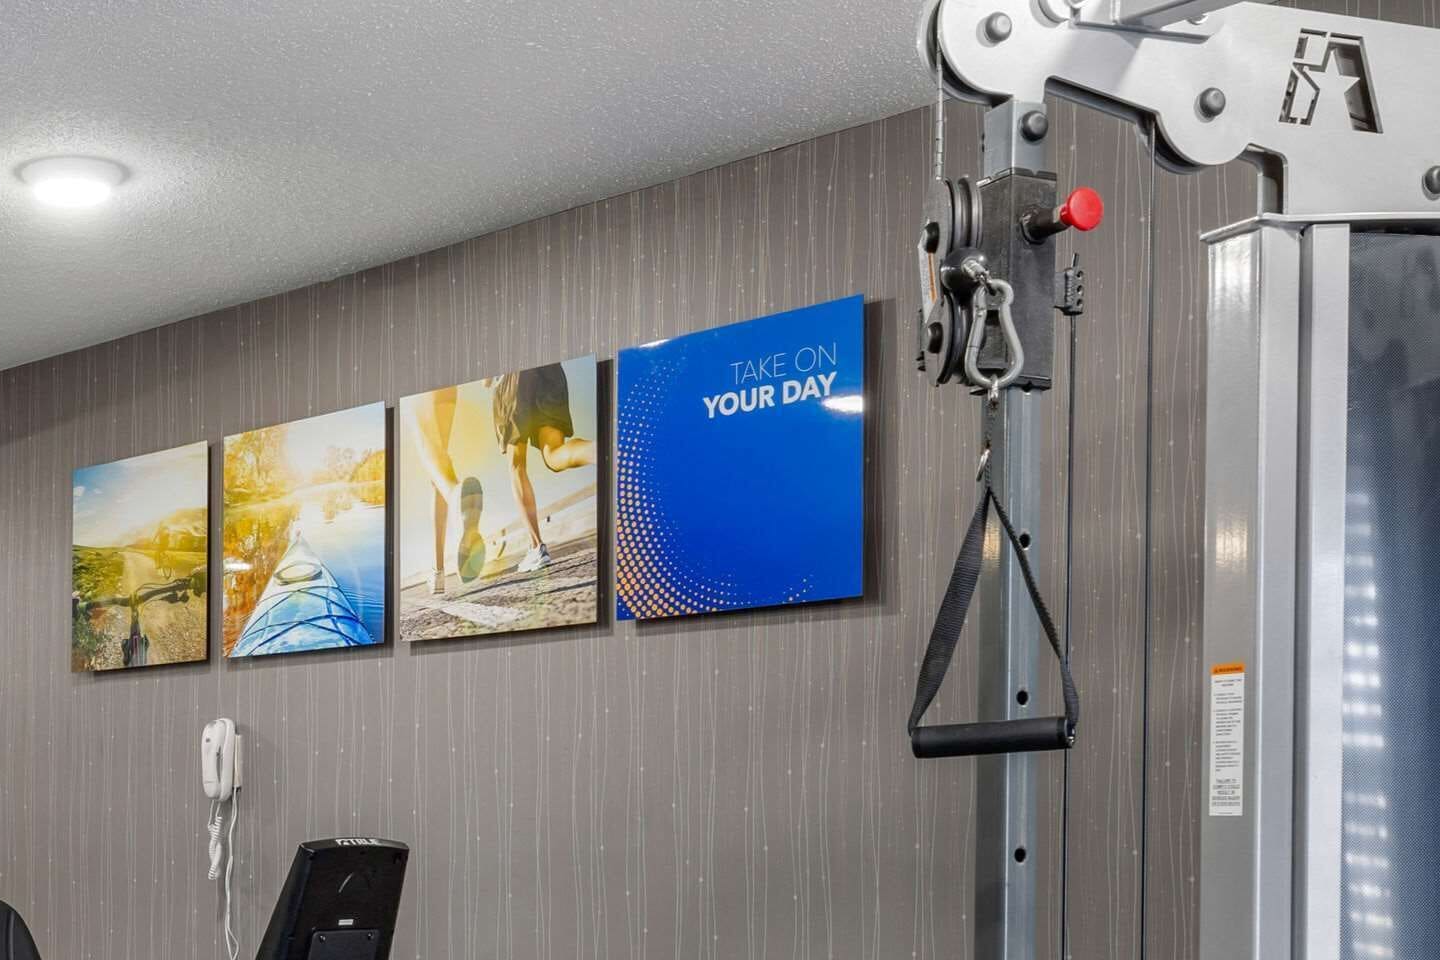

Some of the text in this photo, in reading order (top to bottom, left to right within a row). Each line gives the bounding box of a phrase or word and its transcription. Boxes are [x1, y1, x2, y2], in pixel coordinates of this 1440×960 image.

[730, 342, 837, 385] TAKE ON
[703, 371, 838, 419] YOUR DAY
